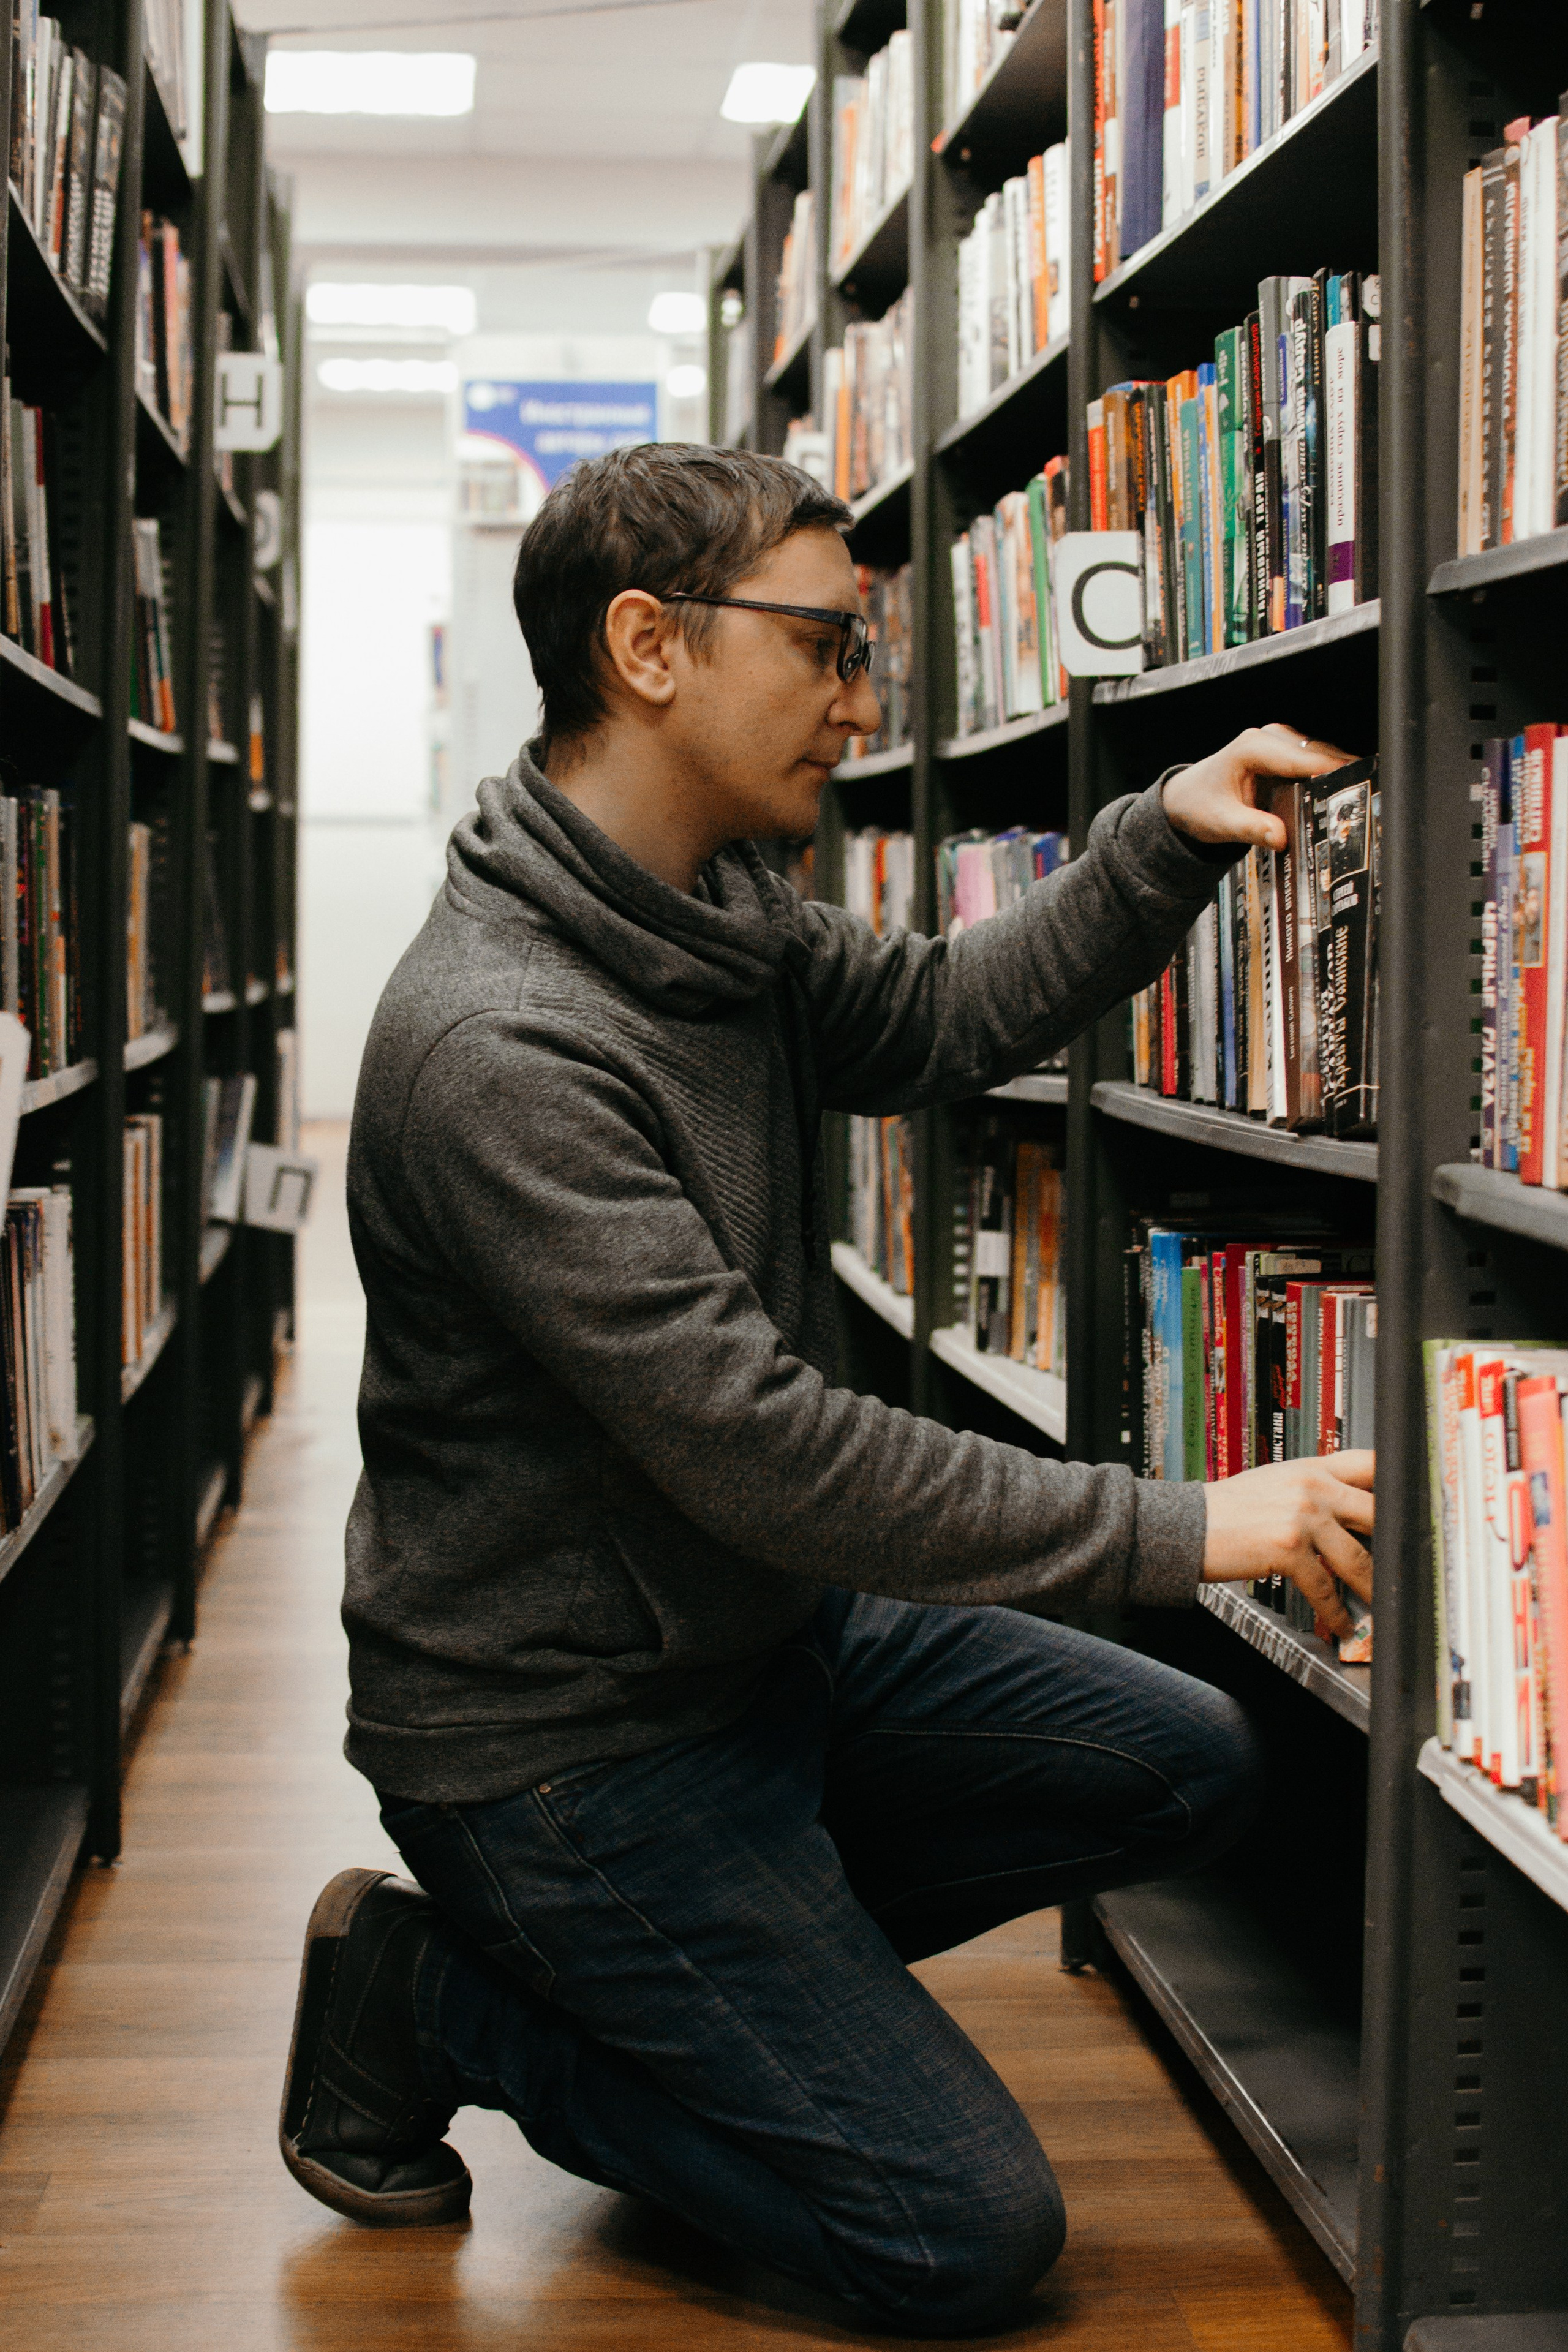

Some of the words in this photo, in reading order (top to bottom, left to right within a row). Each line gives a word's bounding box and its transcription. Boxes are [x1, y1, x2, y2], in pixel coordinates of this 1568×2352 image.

[1196, 66, 1207, 159] РЫБАКОВ
[1293, 318, 1306, 384] Садур
[1294, 386, 1306, 441] Нина
[1337, 387, 1343, 402] на
[1336, 412, 1345, 455] старух
[1254, 471, 1265, 524] ТАРАН
[1336, 462, 1344, 526] праздник
[1255, 529, 1266, 619] ТАНКОВЫЙ
[1333, 925, 1349, 1014] Саянские
[1482, 902, 1497, 1008] ЧЕРНЫЕ
[1333, 1016, 1351, 1088] Хребты
[1481, 1027, 1497, 1108] ГЛАЗА
[1273, 1412, 1284, 1462] нистана
